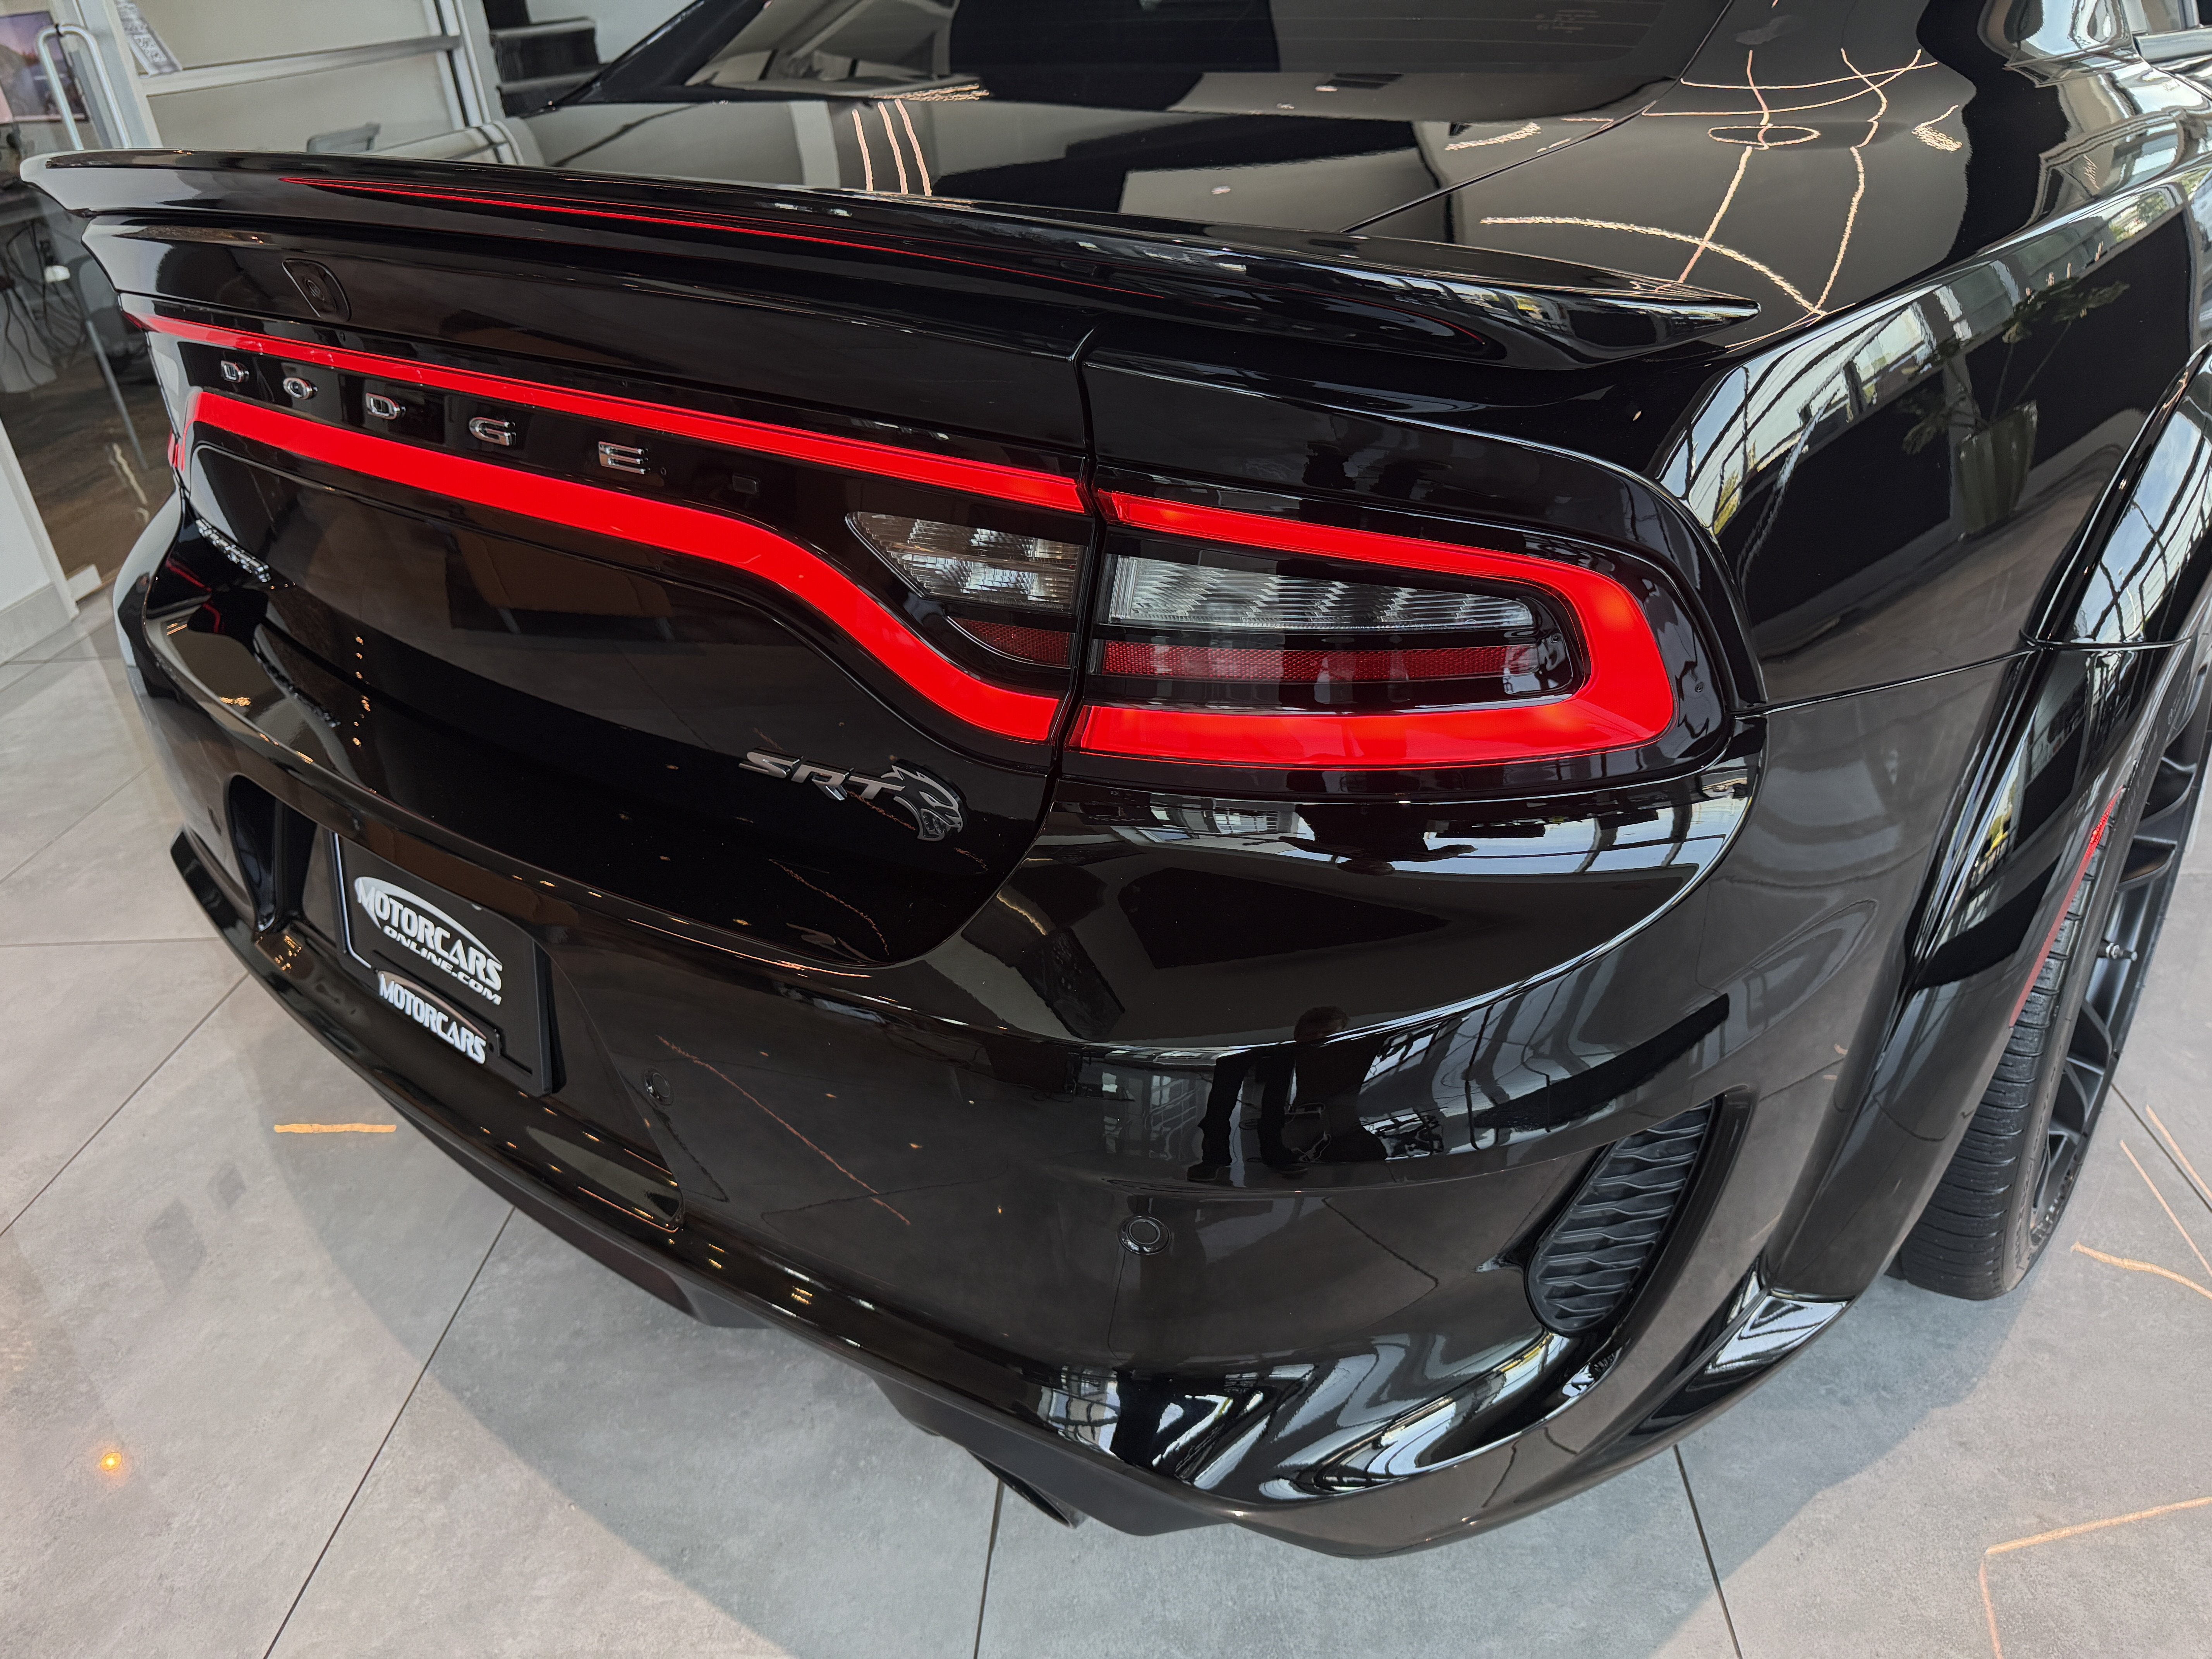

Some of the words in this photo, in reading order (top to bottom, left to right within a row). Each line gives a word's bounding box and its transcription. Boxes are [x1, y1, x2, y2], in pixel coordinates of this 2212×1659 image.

[221, 360, 649, 475] DODGE
[738, 751, 905, 801] SRT
[357, 878, 503, 991] MOTORCARS
[383, 925, 502, 1006] ONLINE.COM
[379, 973, 486, 1064] MOTORCARS
